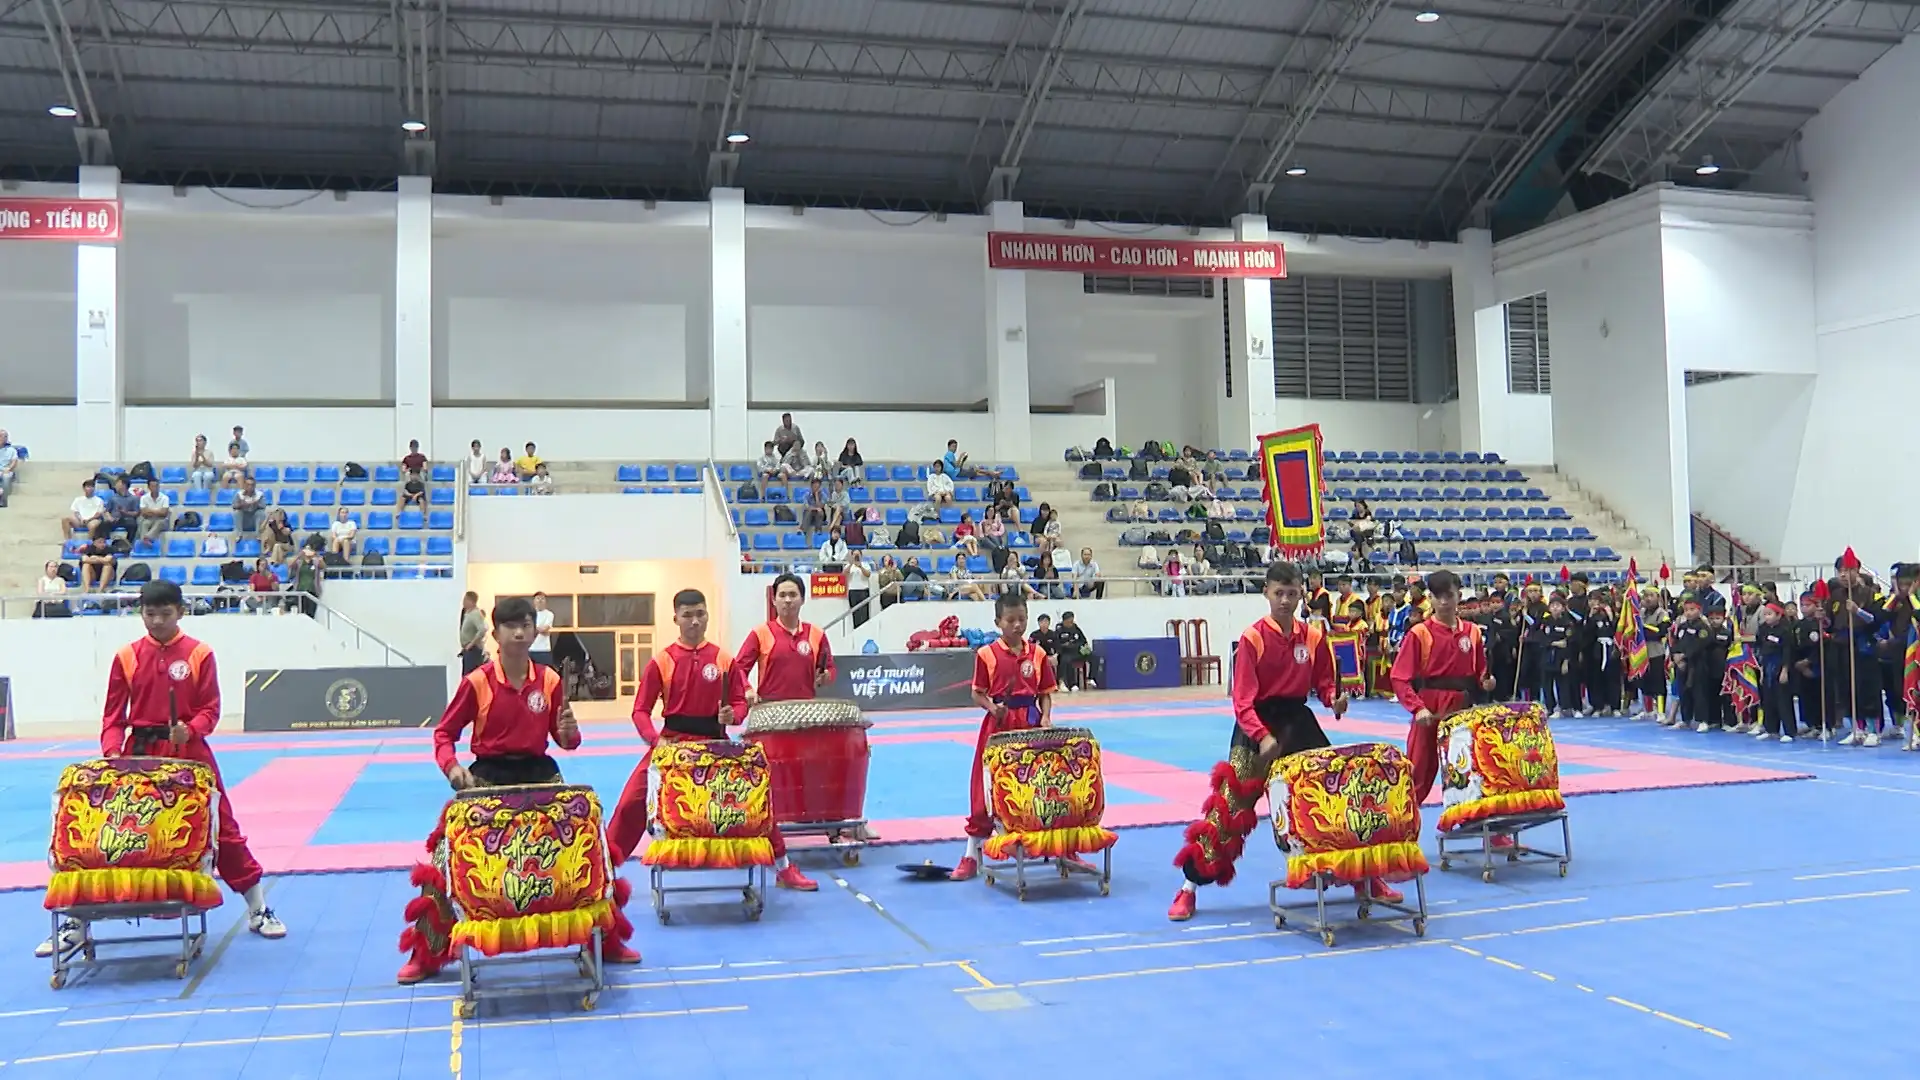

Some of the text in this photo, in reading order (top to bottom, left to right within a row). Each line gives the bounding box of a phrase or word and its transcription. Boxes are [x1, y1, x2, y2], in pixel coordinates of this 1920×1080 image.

[46, 206, 82, 228] TIẾN
[87, 208, 108, 232] BỘ
[1001, 241, 1057, 262] NHANH
[1062, 244, 1095, 263] HƠN
[1110, 247, 1142, 265] CAO
[1146, 246, 1178, 266] HƠN
[1193, 249, 1240, 272] MẠNH
[1244, 248, 1275, 268] HƠN
[852, 679, 925, 699] VIỆT NAM
